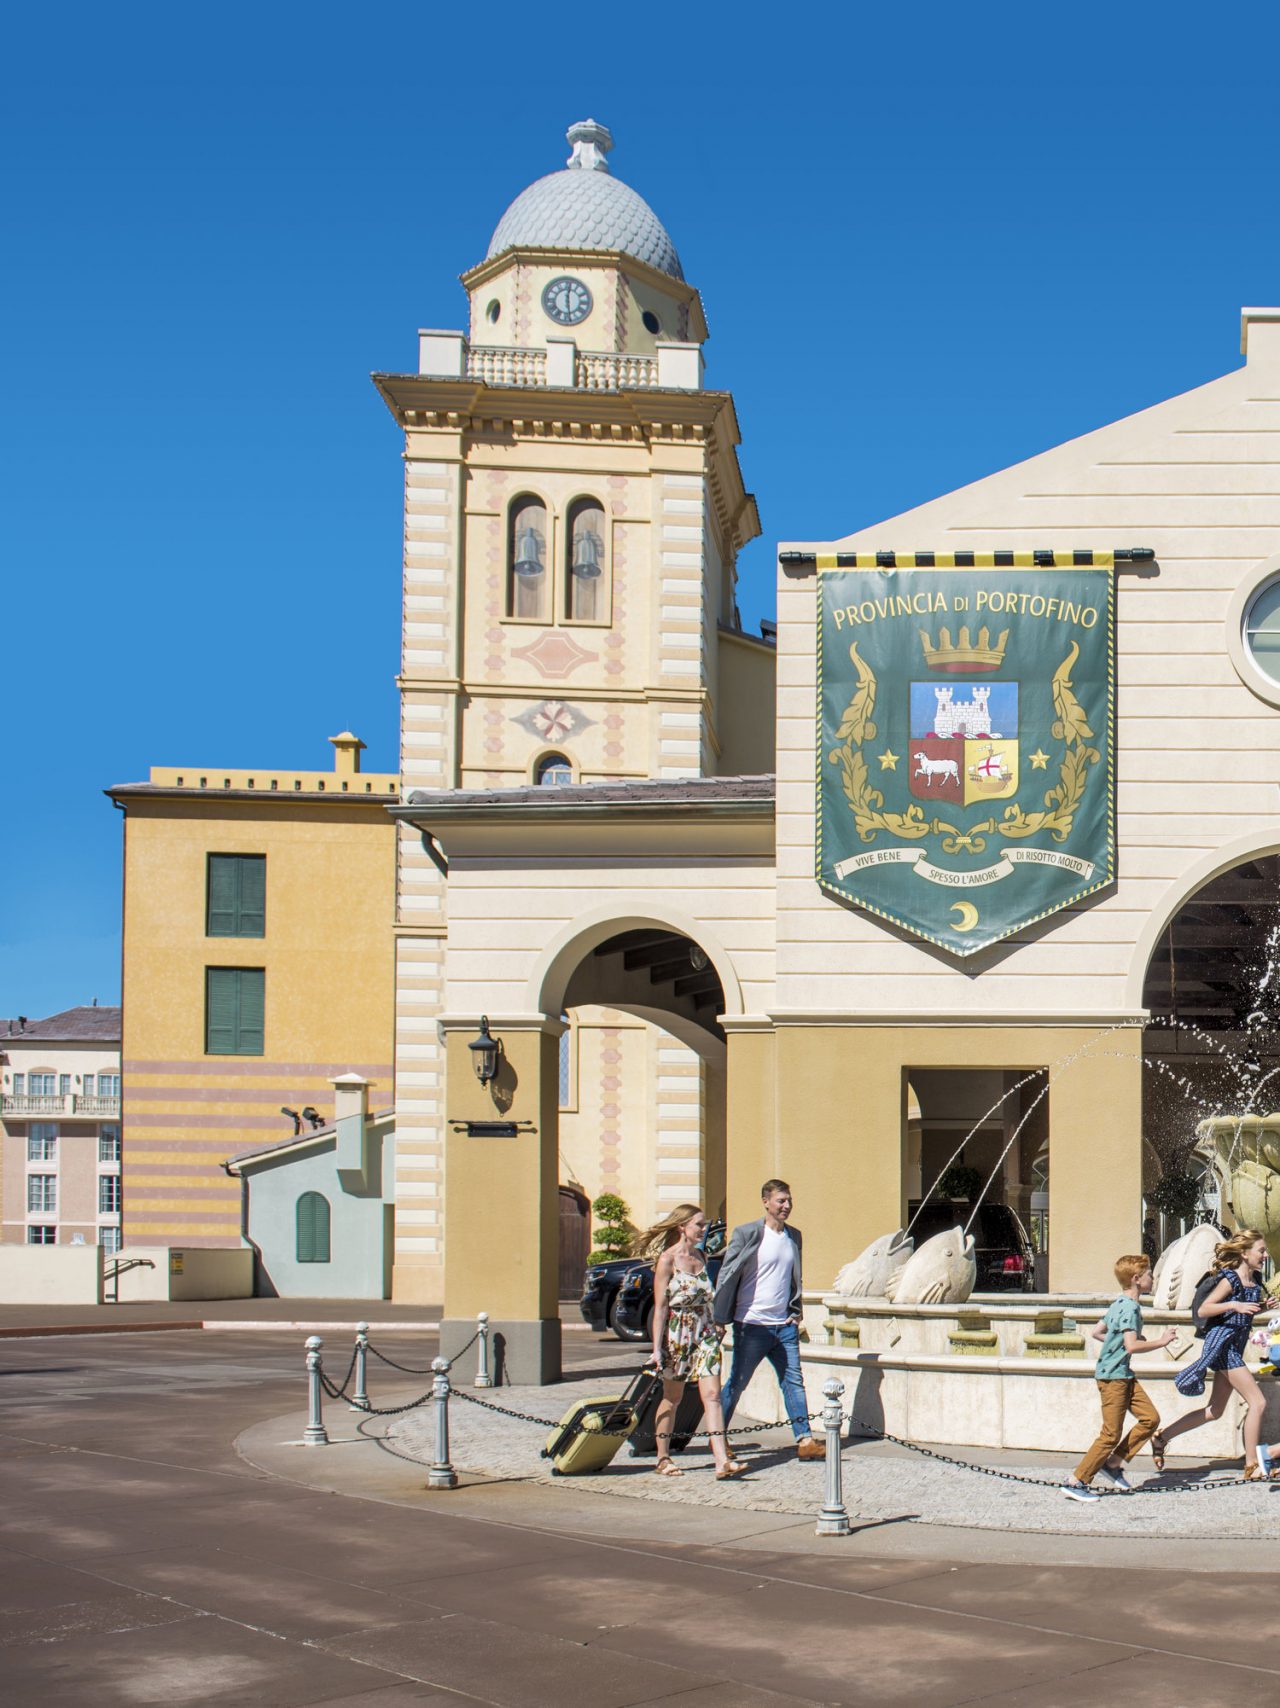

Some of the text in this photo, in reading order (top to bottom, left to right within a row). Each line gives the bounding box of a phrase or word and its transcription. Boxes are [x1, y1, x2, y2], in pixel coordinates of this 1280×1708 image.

[832, 591, 1098, 630] PROVINCIA DI PORTOFINO
[855, 851, 901, 867] VIVE BENE
[1016, 851, 1083, 871] DI RISOTTO MOLTO
[929, 869, 1000, 885] SPESSO L'AMORE
